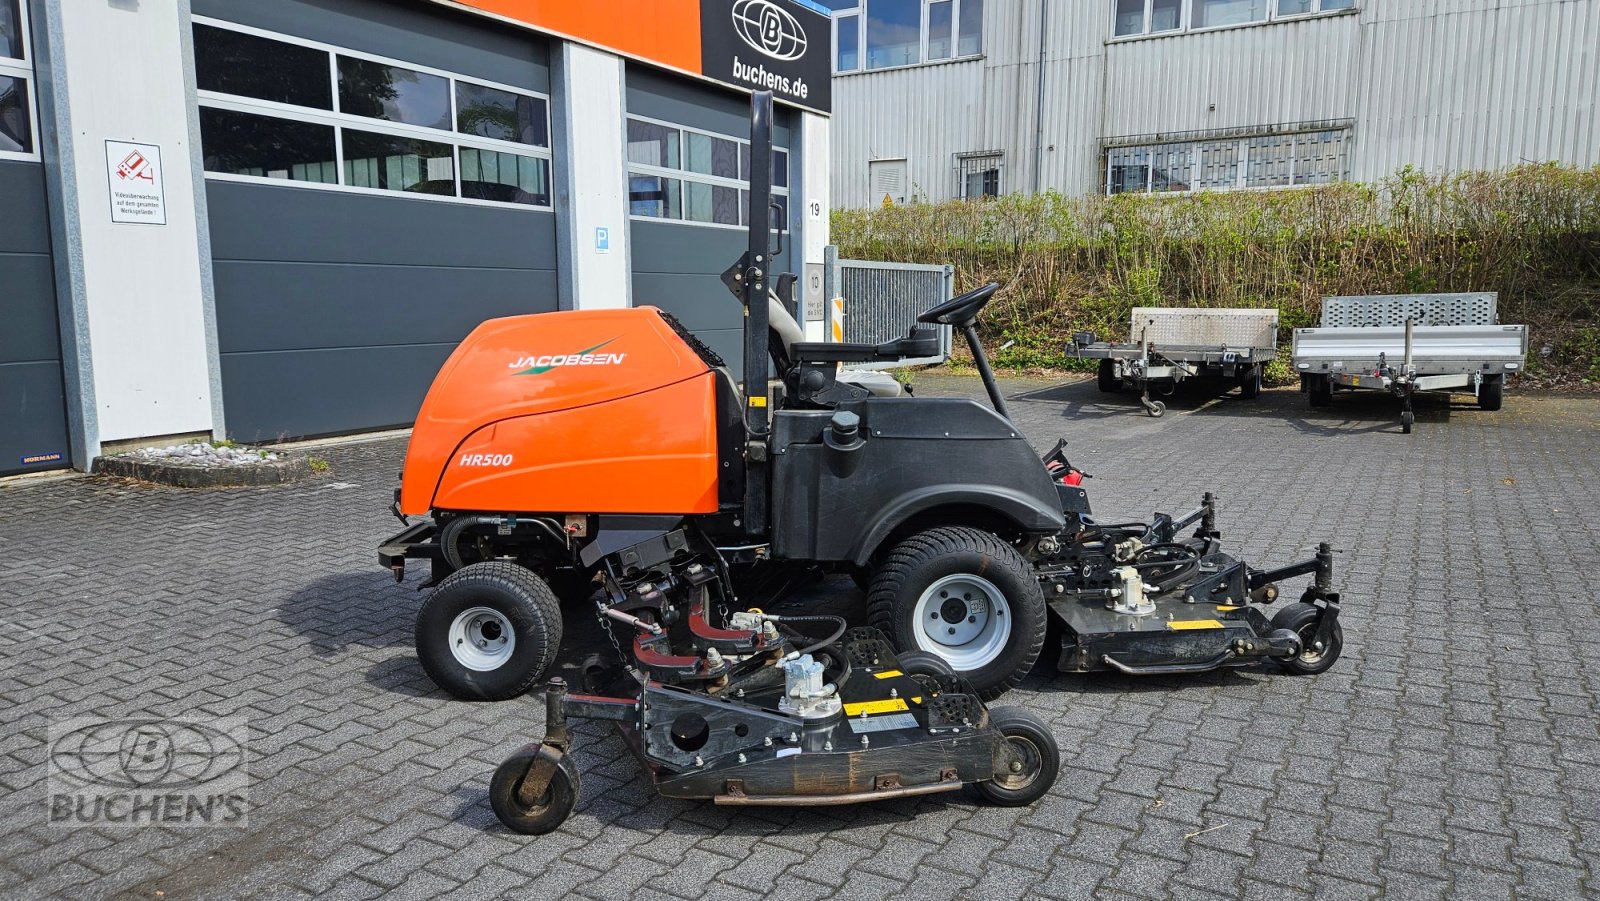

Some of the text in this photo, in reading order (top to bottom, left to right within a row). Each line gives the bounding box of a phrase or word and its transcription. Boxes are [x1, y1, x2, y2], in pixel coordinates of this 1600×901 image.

[763, 11, 780, 45] B
[733, 55, 808, 99] buchens.de
[810, 202, 820, 217] 19
[597, 229, 607, 248] P
[508, 353, 625, 368] JACOBSEN
[459, 453, 513, 467] HR500
